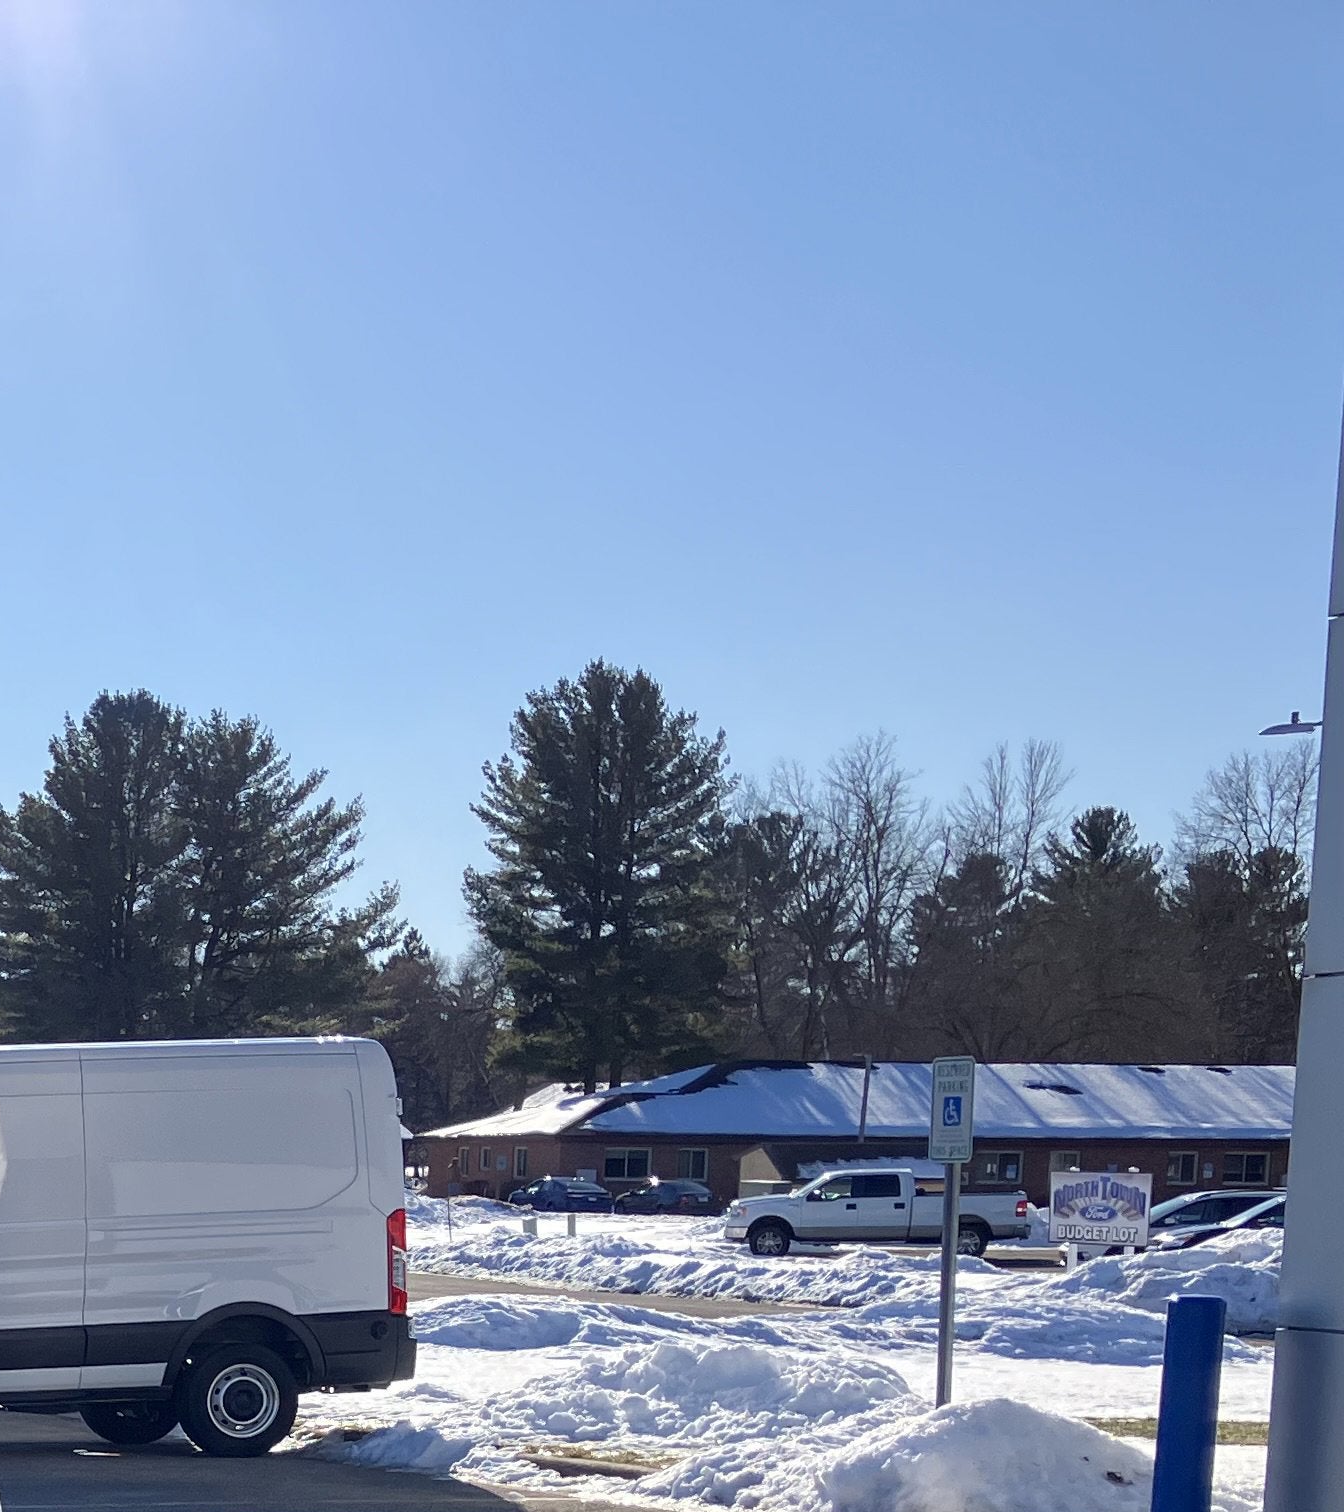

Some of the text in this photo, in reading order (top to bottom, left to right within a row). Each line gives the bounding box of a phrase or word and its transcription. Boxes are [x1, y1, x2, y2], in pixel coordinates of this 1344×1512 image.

[1085, 1206, 1111, 1220] Ford
[1057, 1225, 1137, 1242] BUDGET LOT
